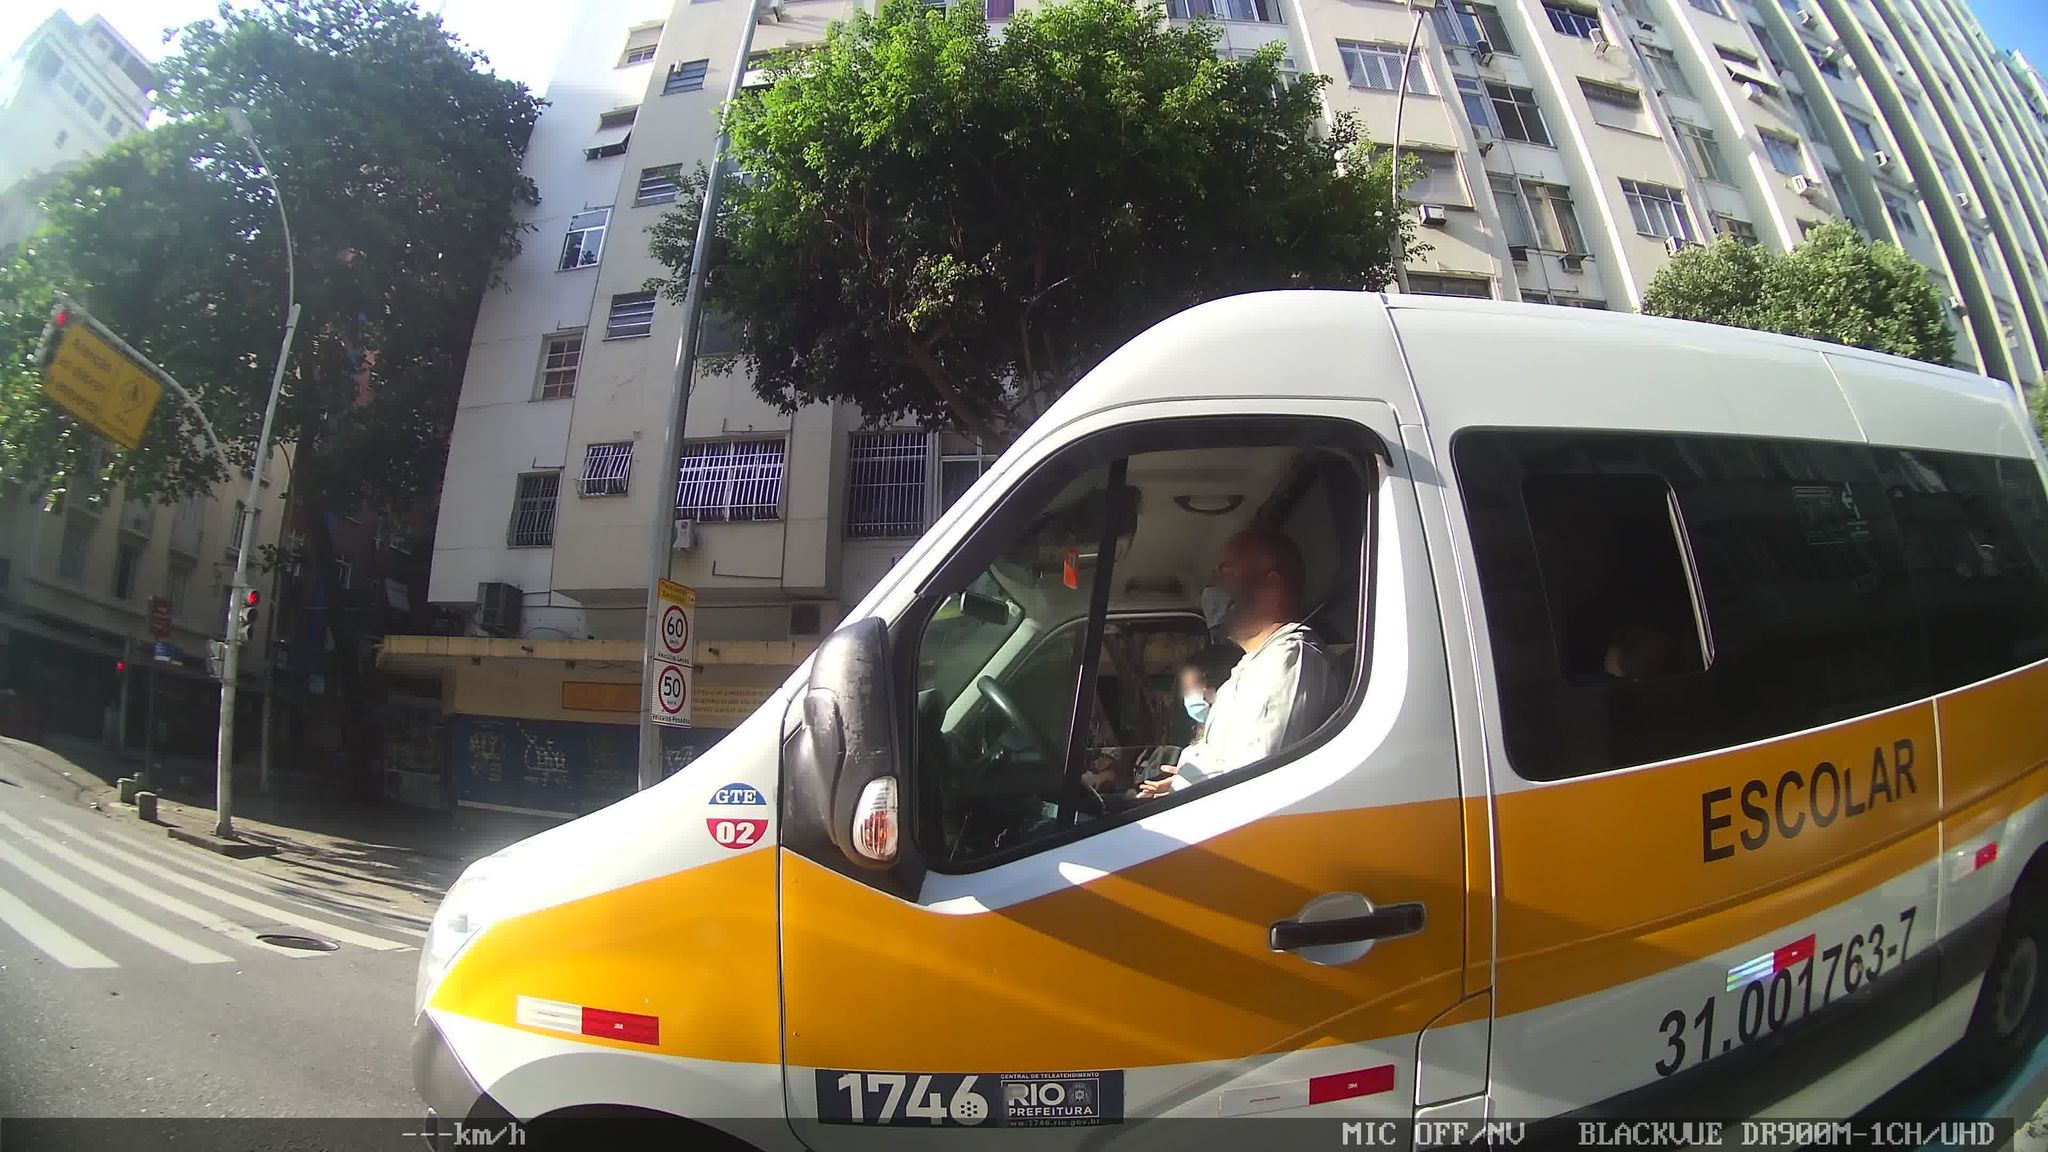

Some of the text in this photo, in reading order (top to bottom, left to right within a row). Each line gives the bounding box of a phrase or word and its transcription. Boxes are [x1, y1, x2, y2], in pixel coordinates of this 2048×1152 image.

[666, 616, 684, 638] 60
[663, 676, 681, 698] 50
[715, 789, 757, 804] GTE
[1701, 738, 1919, 864] ESCOLAR
[716, 821, 755, 844] 02
[1655, 906, 1917, 1077] 31.001763-7
[838, 1072, 989, 1126] 1746
[1007, 1082, 1066, 1106] RIO
[1004, 1118, 1100, 1127] ww.1746.rio.gov.br
[1008, 1106, 1093, 1117] PREFEITURA
